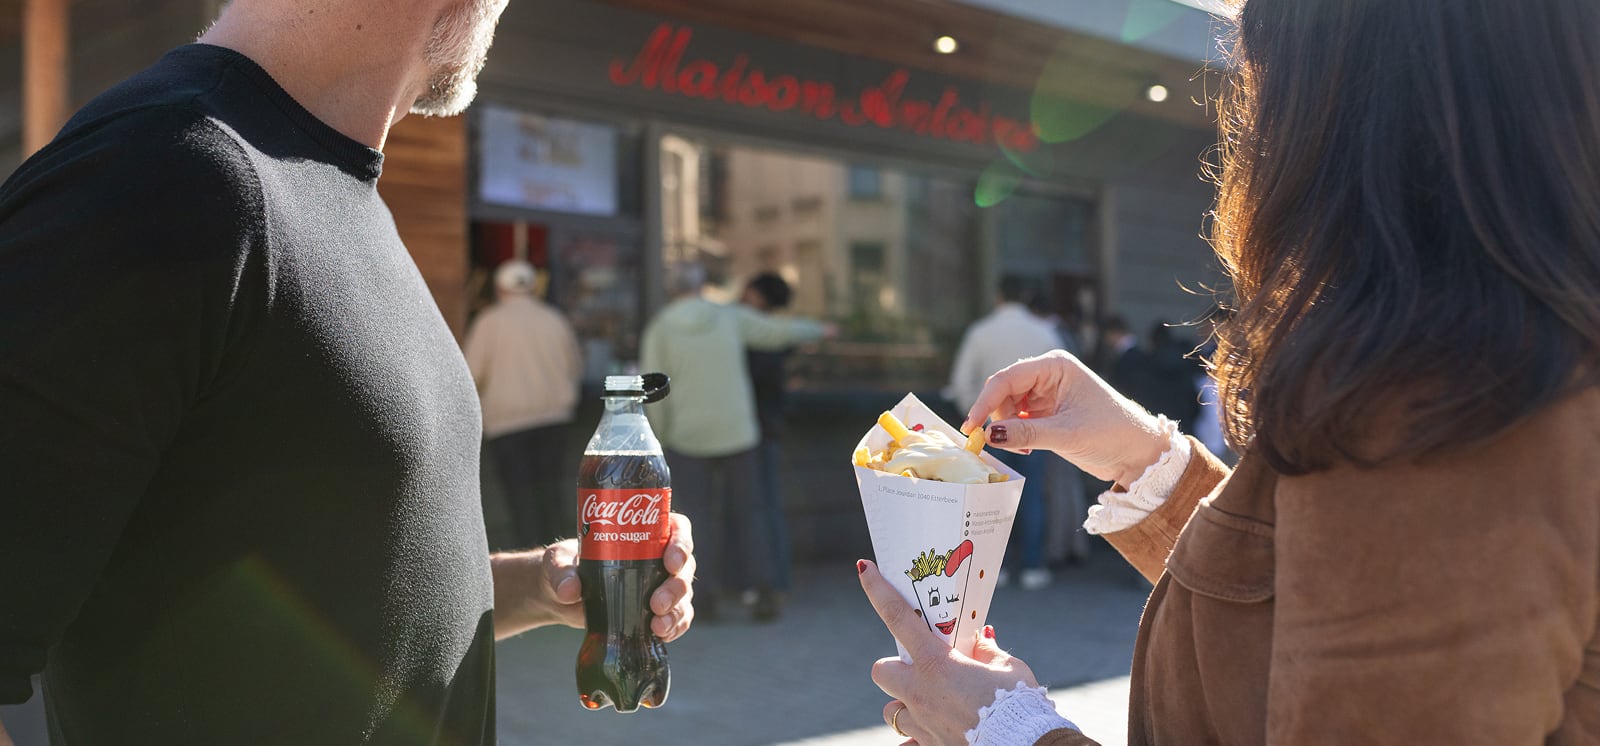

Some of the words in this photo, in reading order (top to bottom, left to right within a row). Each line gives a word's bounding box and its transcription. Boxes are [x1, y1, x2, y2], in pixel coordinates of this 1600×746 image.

[608, 21, 836, 119] Maison
[840, 68, 1041, 153] Antoine
[582, 494, 663, 525] Coca-Cola
[593, 531, 618, 541] zero
[620, 531, 651, 543] sugar
